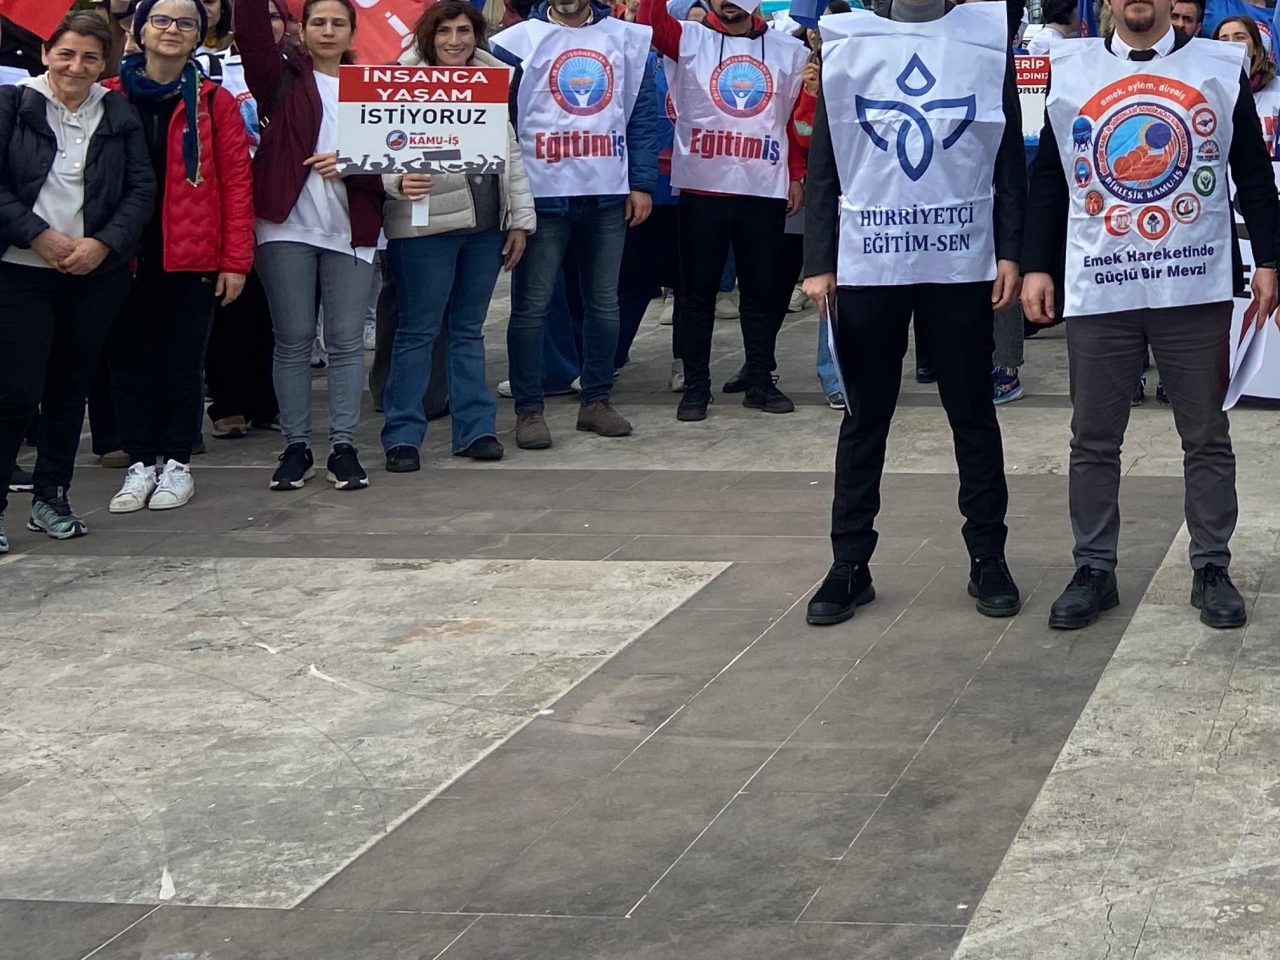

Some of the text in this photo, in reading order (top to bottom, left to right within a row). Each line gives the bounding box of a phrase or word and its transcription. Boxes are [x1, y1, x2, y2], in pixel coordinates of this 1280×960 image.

[363, 67, 488, 84] İNSANCA
[376, 88, 472, 102] YAŞAM
[1100, 81, 1187, 106] emek, eylem, direniş
[360, 104, 487, 124] İSTİYORUZ
[409, 134, 460, 147] KAMU-İŞ
[535, 129, 625, 164] Eğitimiş
[690, 127, 780, 166] Eğitimiş
[1105, 176, 1144, 200] BİRLEŞİK
[860, 202, 974, 229] HÜRRİYETÇİ
[863, 232, 971, 254] EĞİTİM-SEN
[1083, 244, 1215, 267] Emek Hareketinde
[1095, 262, 1206, 285] Güçlü Bir Mevzi
